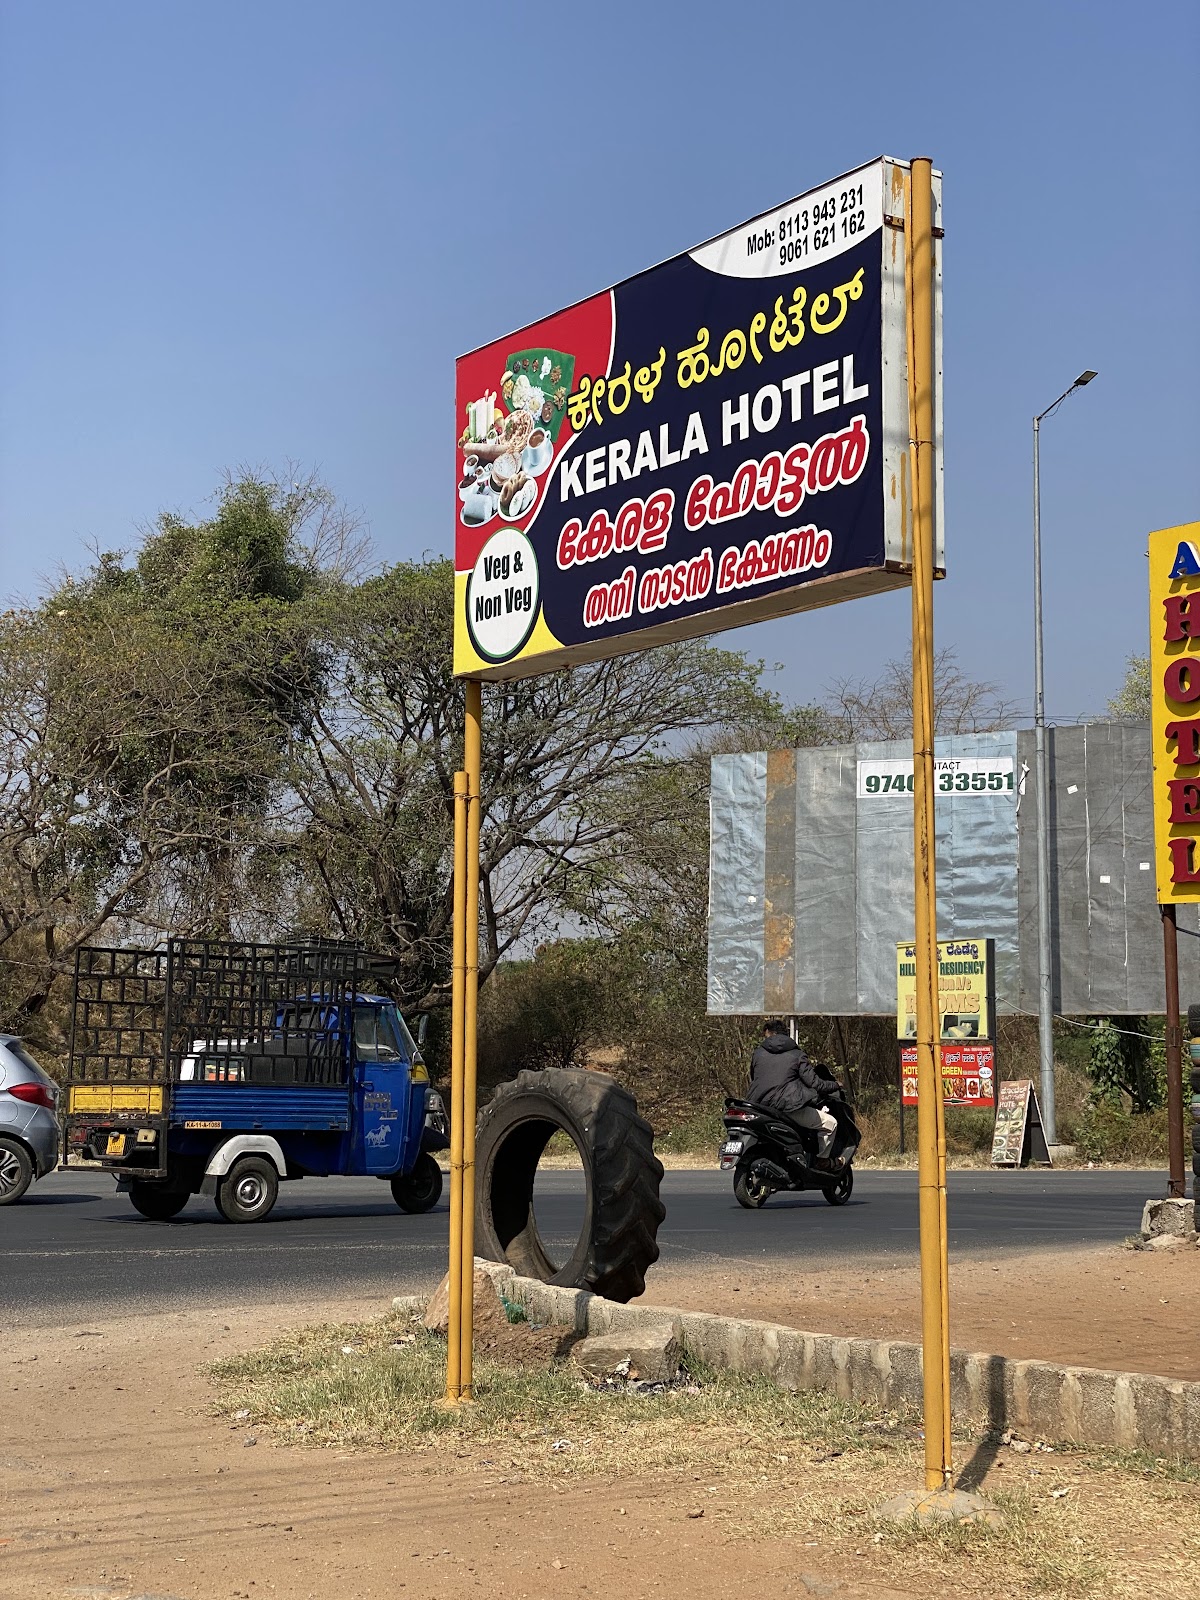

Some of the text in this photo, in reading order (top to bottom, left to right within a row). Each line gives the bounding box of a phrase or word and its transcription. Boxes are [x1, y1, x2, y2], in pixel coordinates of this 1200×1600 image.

[747, 184, 863, 256] Mob: 8113 943 231
[780, 210, 865, 266] 9061 621 162
[567, 267, 865, 431] ಕೇರಳ ಹೋಟೆಲ್
[560, 354, 869, 502] KERALA HOTEL
[558, 416, 869, 569] കേരള ഹോട്ടൽ
[484, 550, 524, 582] Veg &
[584, 525, 832, 627] തനി നാടൻ ഭക്ഷണം
[475, 586, 532, 623] Non Veg
[940, 960, 985, 976] RESIDENCY
[941, 1066, 963, 1076] GREEN
